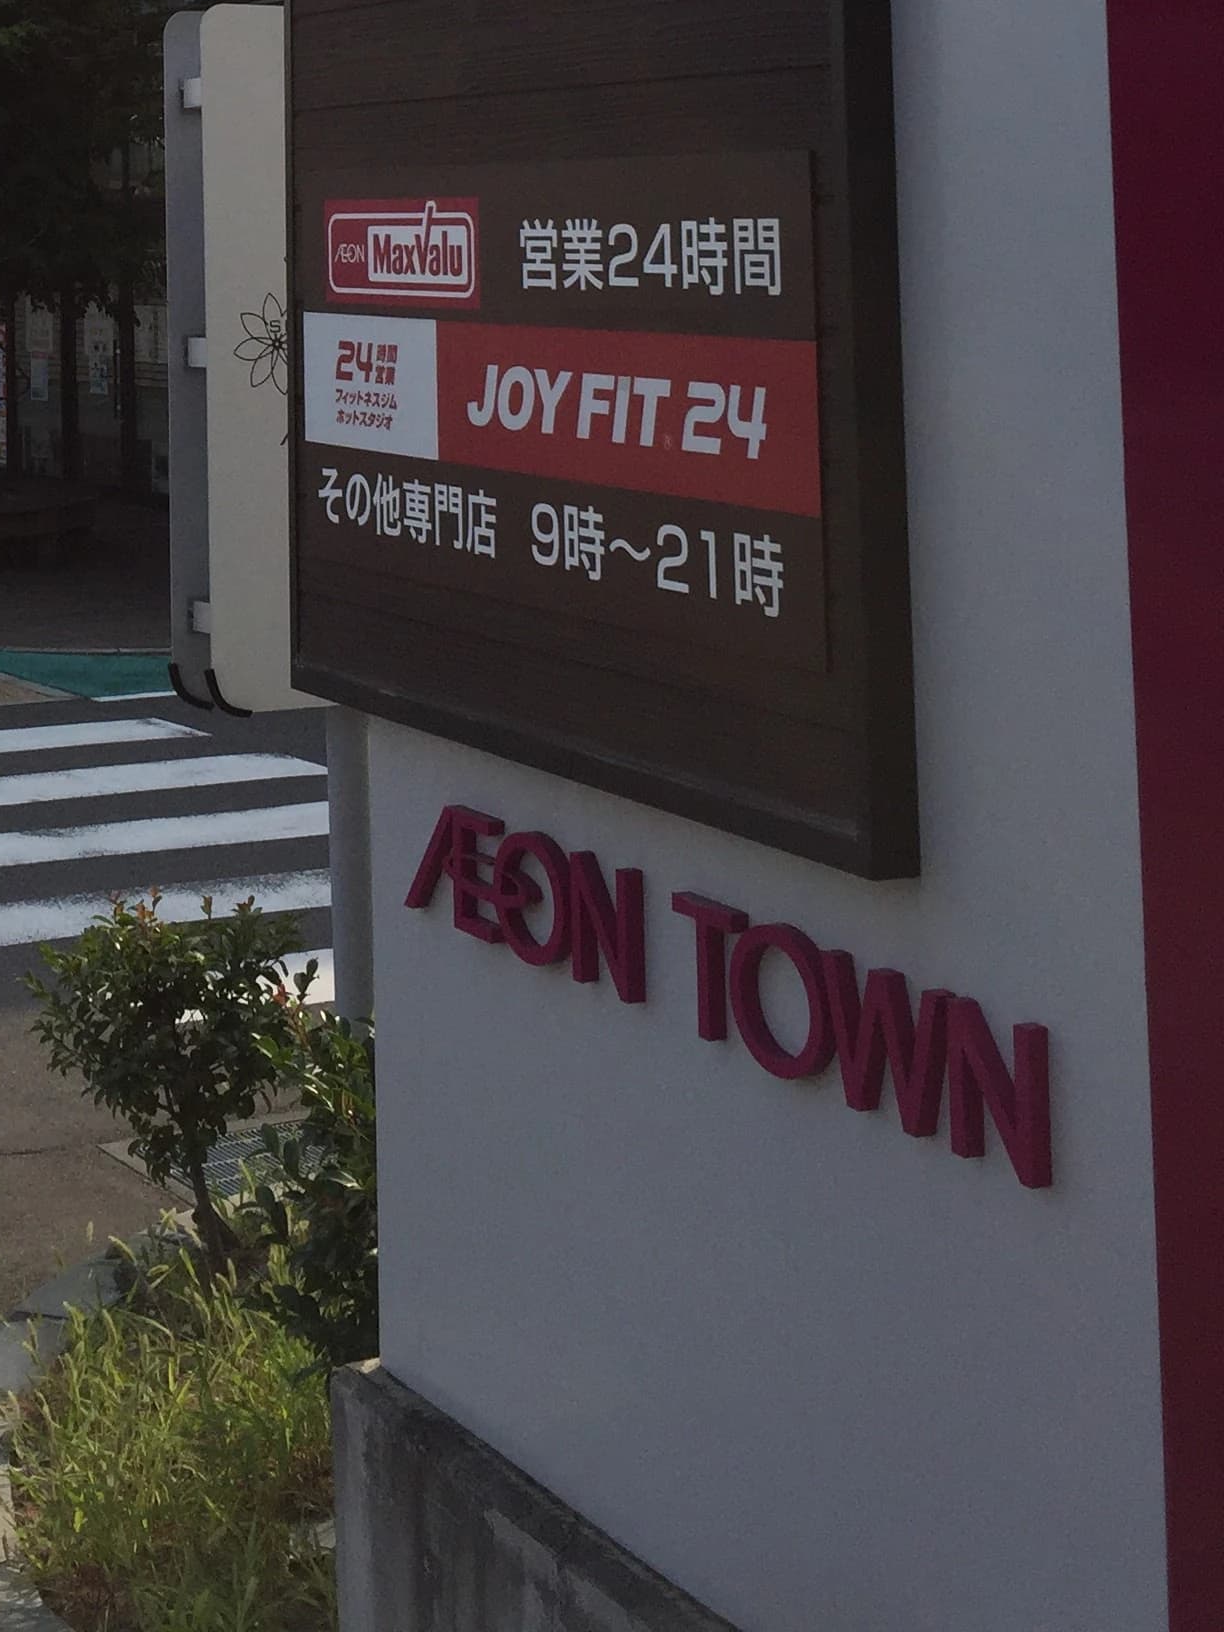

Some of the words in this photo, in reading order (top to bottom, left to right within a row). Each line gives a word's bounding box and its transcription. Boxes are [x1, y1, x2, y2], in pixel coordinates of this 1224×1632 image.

[372, 205, 463, 277] MaxValu
[519, 217, 782, 296] 営業24時間
[335, 388, 398, 410] フィットネスジム
[335, 409, 393, 430] ホットスタジオ
[681, 381, 768, 460] 24
[317, 468, 497, 559] その他専門店
[671, 891, 1053, 1189] TOWN
